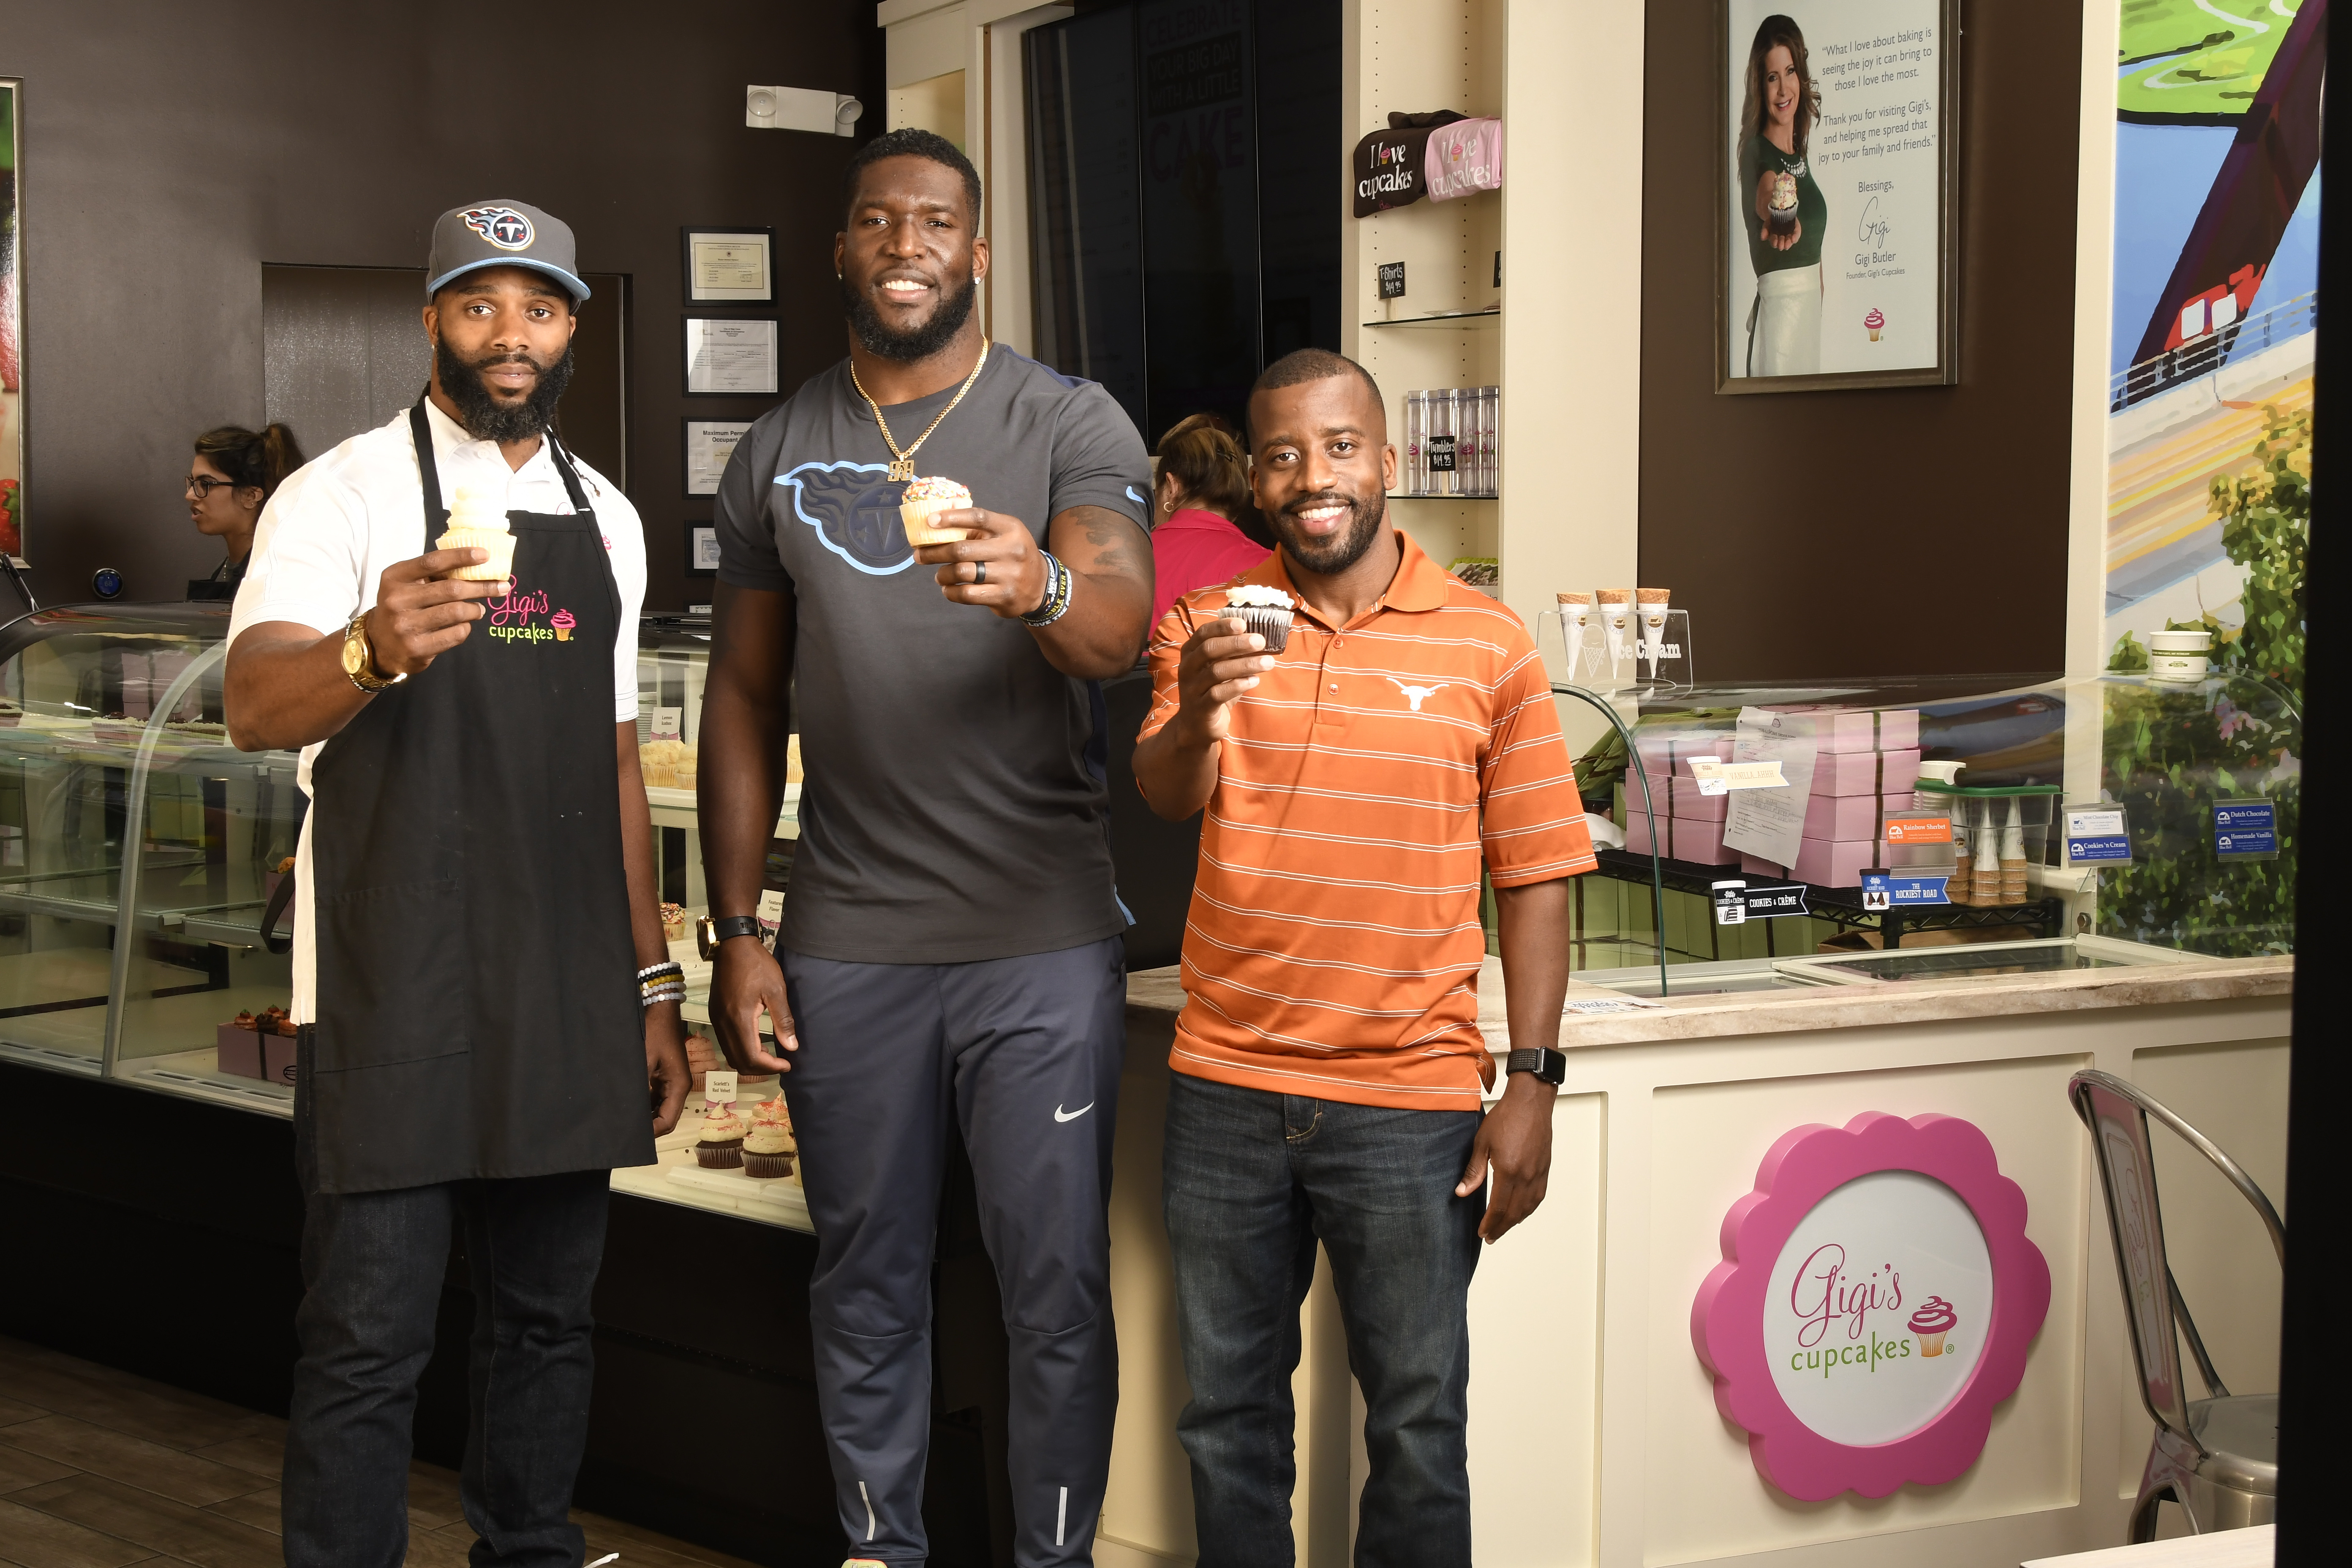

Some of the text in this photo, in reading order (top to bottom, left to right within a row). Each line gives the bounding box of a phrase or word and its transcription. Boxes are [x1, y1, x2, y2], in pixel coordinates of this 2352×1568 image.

[1850, 41, 1852, 52] I
[1854, 40, 1870, 52] love
[1873, 36, 1895, 48] about
[1897, 30, 1923, 43] baking
[1925, 29, 1932, 38] is
[1151, 38, 1238, 82] YOUR BIG DAY
[1822, 48, 1932, 76] seeing the joy it can bring to
[1151, 82, 1182, 108] WITH
[1186, 82, 1194, 103] A
[1198, 68, 1239, 100] LITTLE
[1835, 68, 1919, 91] those I love the most.
[1823, 113, 1846, 126] Thank
[1848, 113, 1862, 126] you
[1865, 108, 1877, 120] for
[1878, 105, 1906, 117] visiting
[1824, 119, 1928, 144] and helping me spread that
[1149, 105, 1244, 183] CAKE
[1818, 153, 1830, 166] joy
[1832, 152, 1840, 161] to
[1842, 150, 1860, 163] your
[1862, 143, 1884, 157] family
[1886, 140, 1901, 153] and
[1358, 164, 1413, 200] cupcakes
[1432, 160, 1491, 197] cupcakes
[1858, 180, 1894, 193] Blessings,
[1858, 196, 1891, 249] Gigi
[1855, 251, 1896, 267] Gigi Butler
[1379, 264, 1403, 280] T-Shirts
[1867, 269, 1880, 279] Gigi's
[1881, 267, 1905, 278] Cupcakes
[1429, 439, 1455, 454] Tumblers
[1027, 619, 1052, 627] LOVE
[1052, 605, 1068, 621] THE
[489, 622, 553, 645] cupcakes
[1749, 898, 1772, 908] COOKIES
[1778, 895, 1797, 906] CRÈME
[1895, 889, 1937, 898] ROCKIEST ROAD
[1791, 1243, 1902, 1348] Gigi's
[1791, 1331, 1911, 1379] cupcakes
